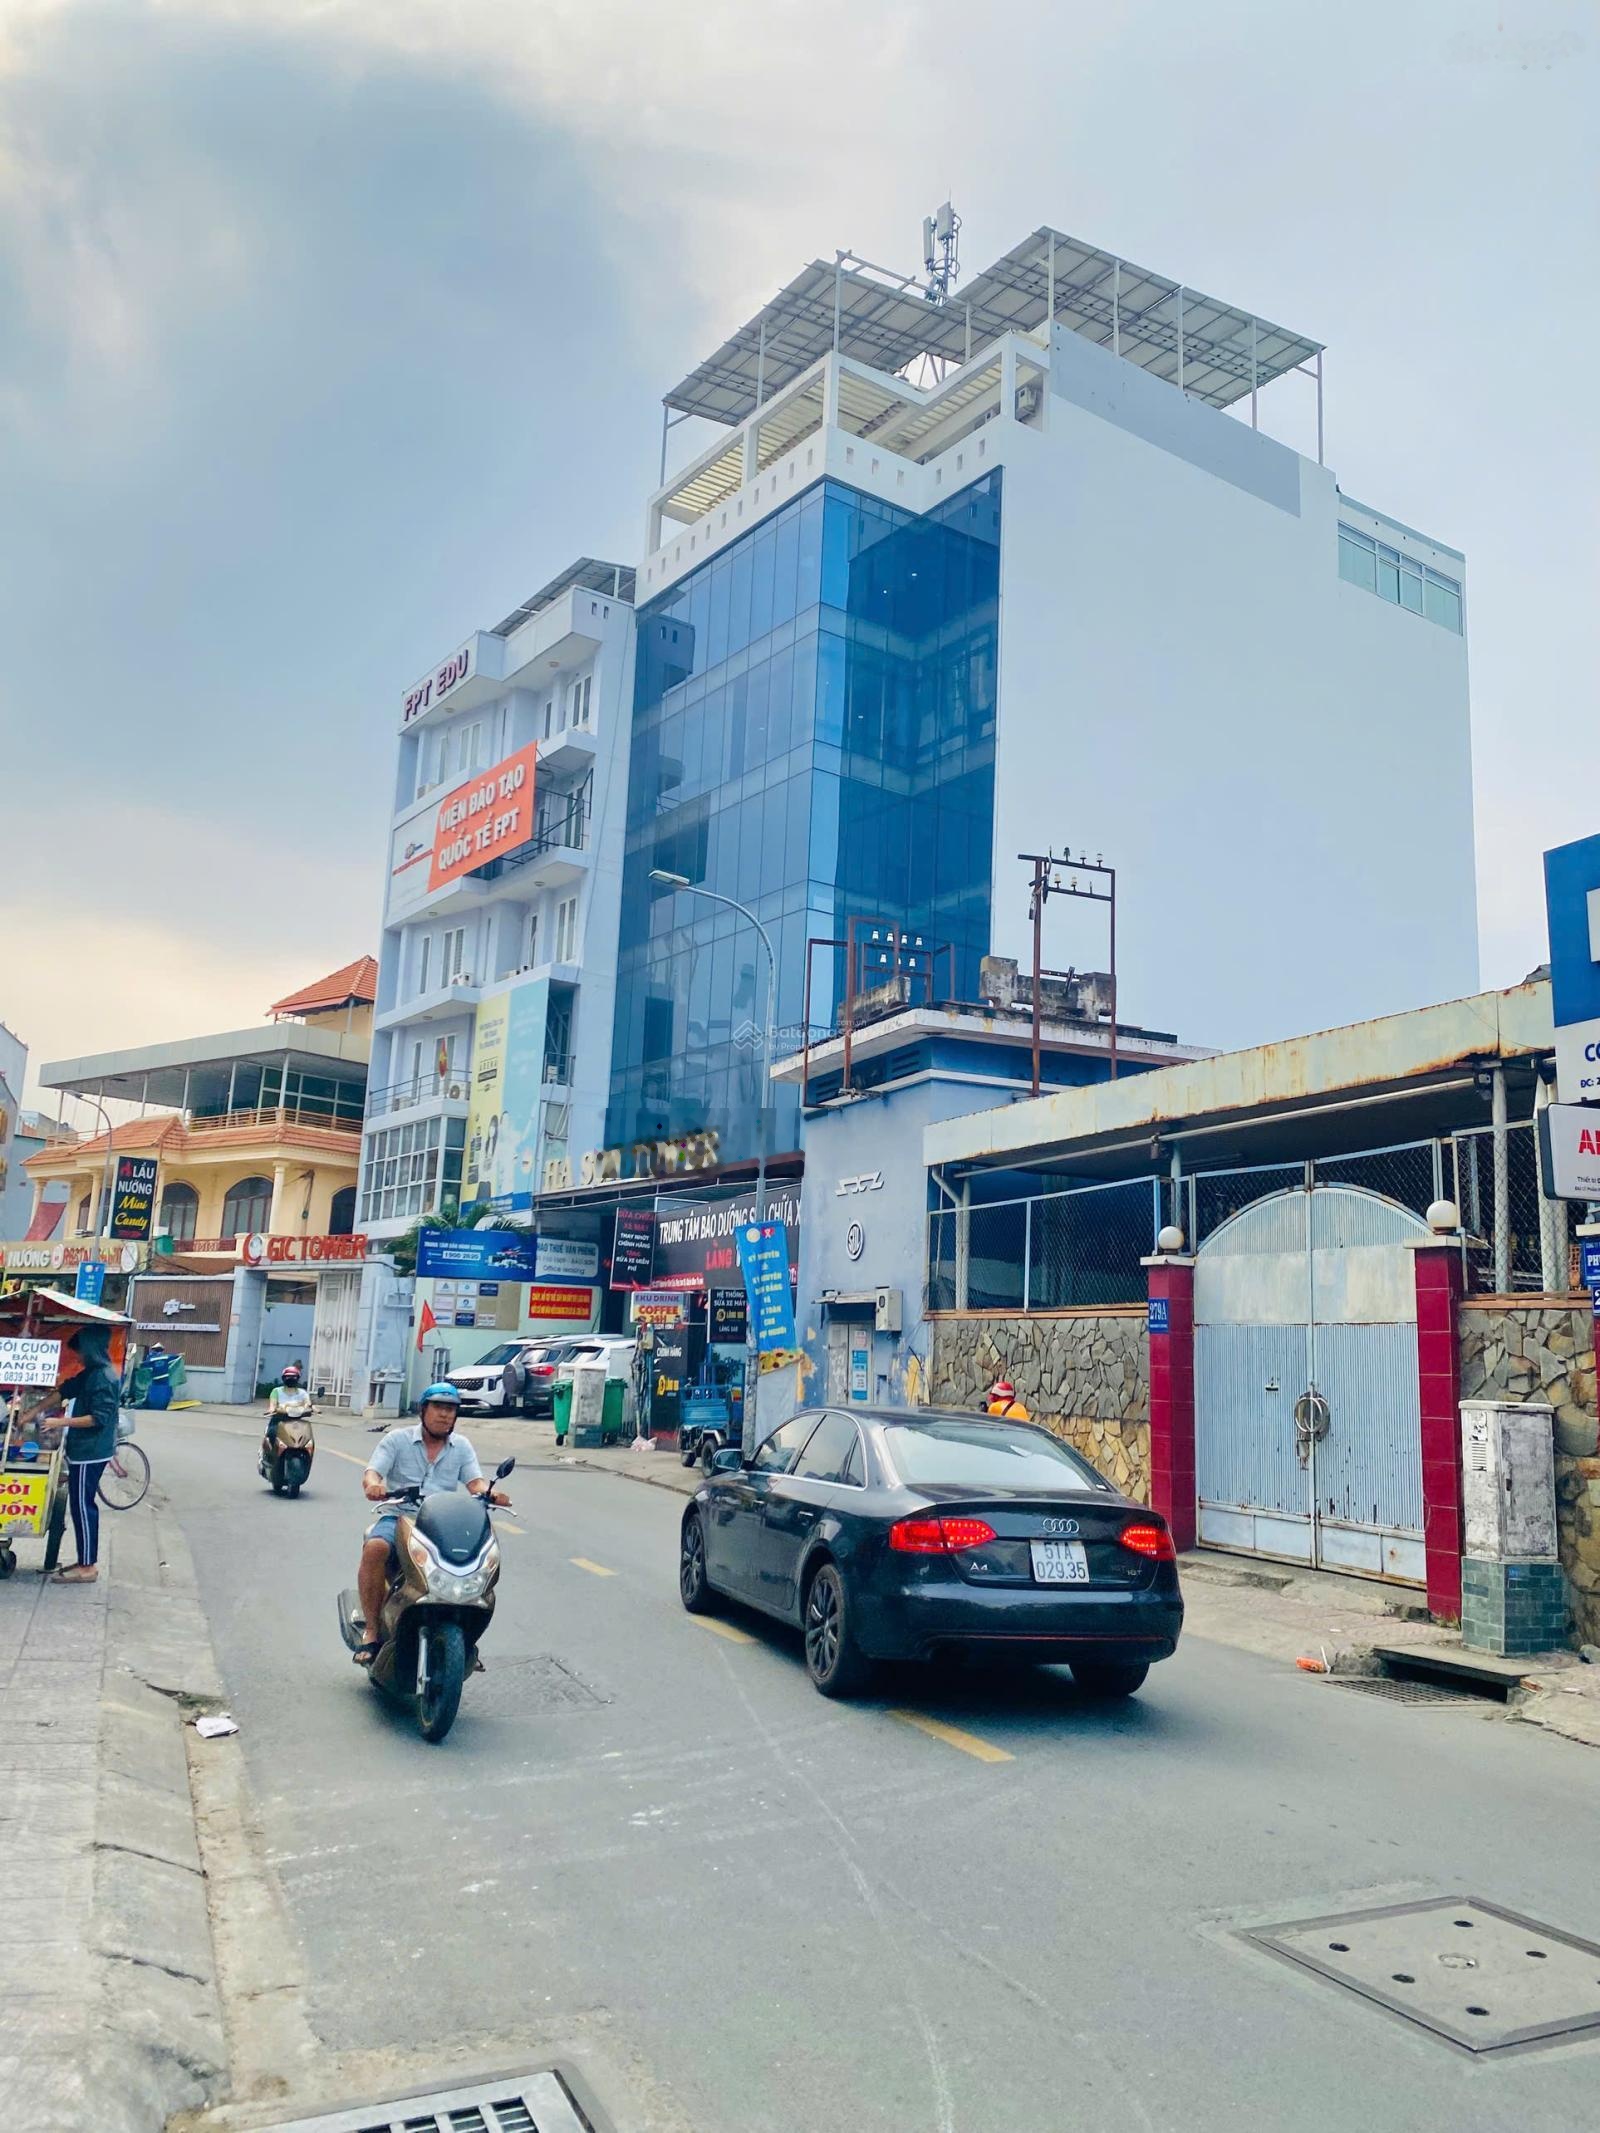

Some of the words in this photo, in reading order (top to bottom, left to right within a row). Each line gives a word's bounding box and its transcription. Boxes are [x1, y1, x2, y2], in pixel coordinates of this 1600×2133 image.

[404, 680, 432, 722] FPT
[436, 649, 469, 697] EDU
[498, 764, 526, 801] TẠO
[494, 807, 522, 843] FPT
[119, 1195, 149, 1210] Mini
[115, 1212, 149, 1230] Candy
[659, 1219, 684, 1245] TRUNG
[684, 1210, 700, 1241] TÂM
[700, 1206, 717, 1239] BẢO
[639, 1305, 679, 1315] COFFEE
[1043, 1541, 1073, 1559] 51A
[970, 1562, 988, 1571] A4
[1037, 1561, 1086, 1580] 029.35
